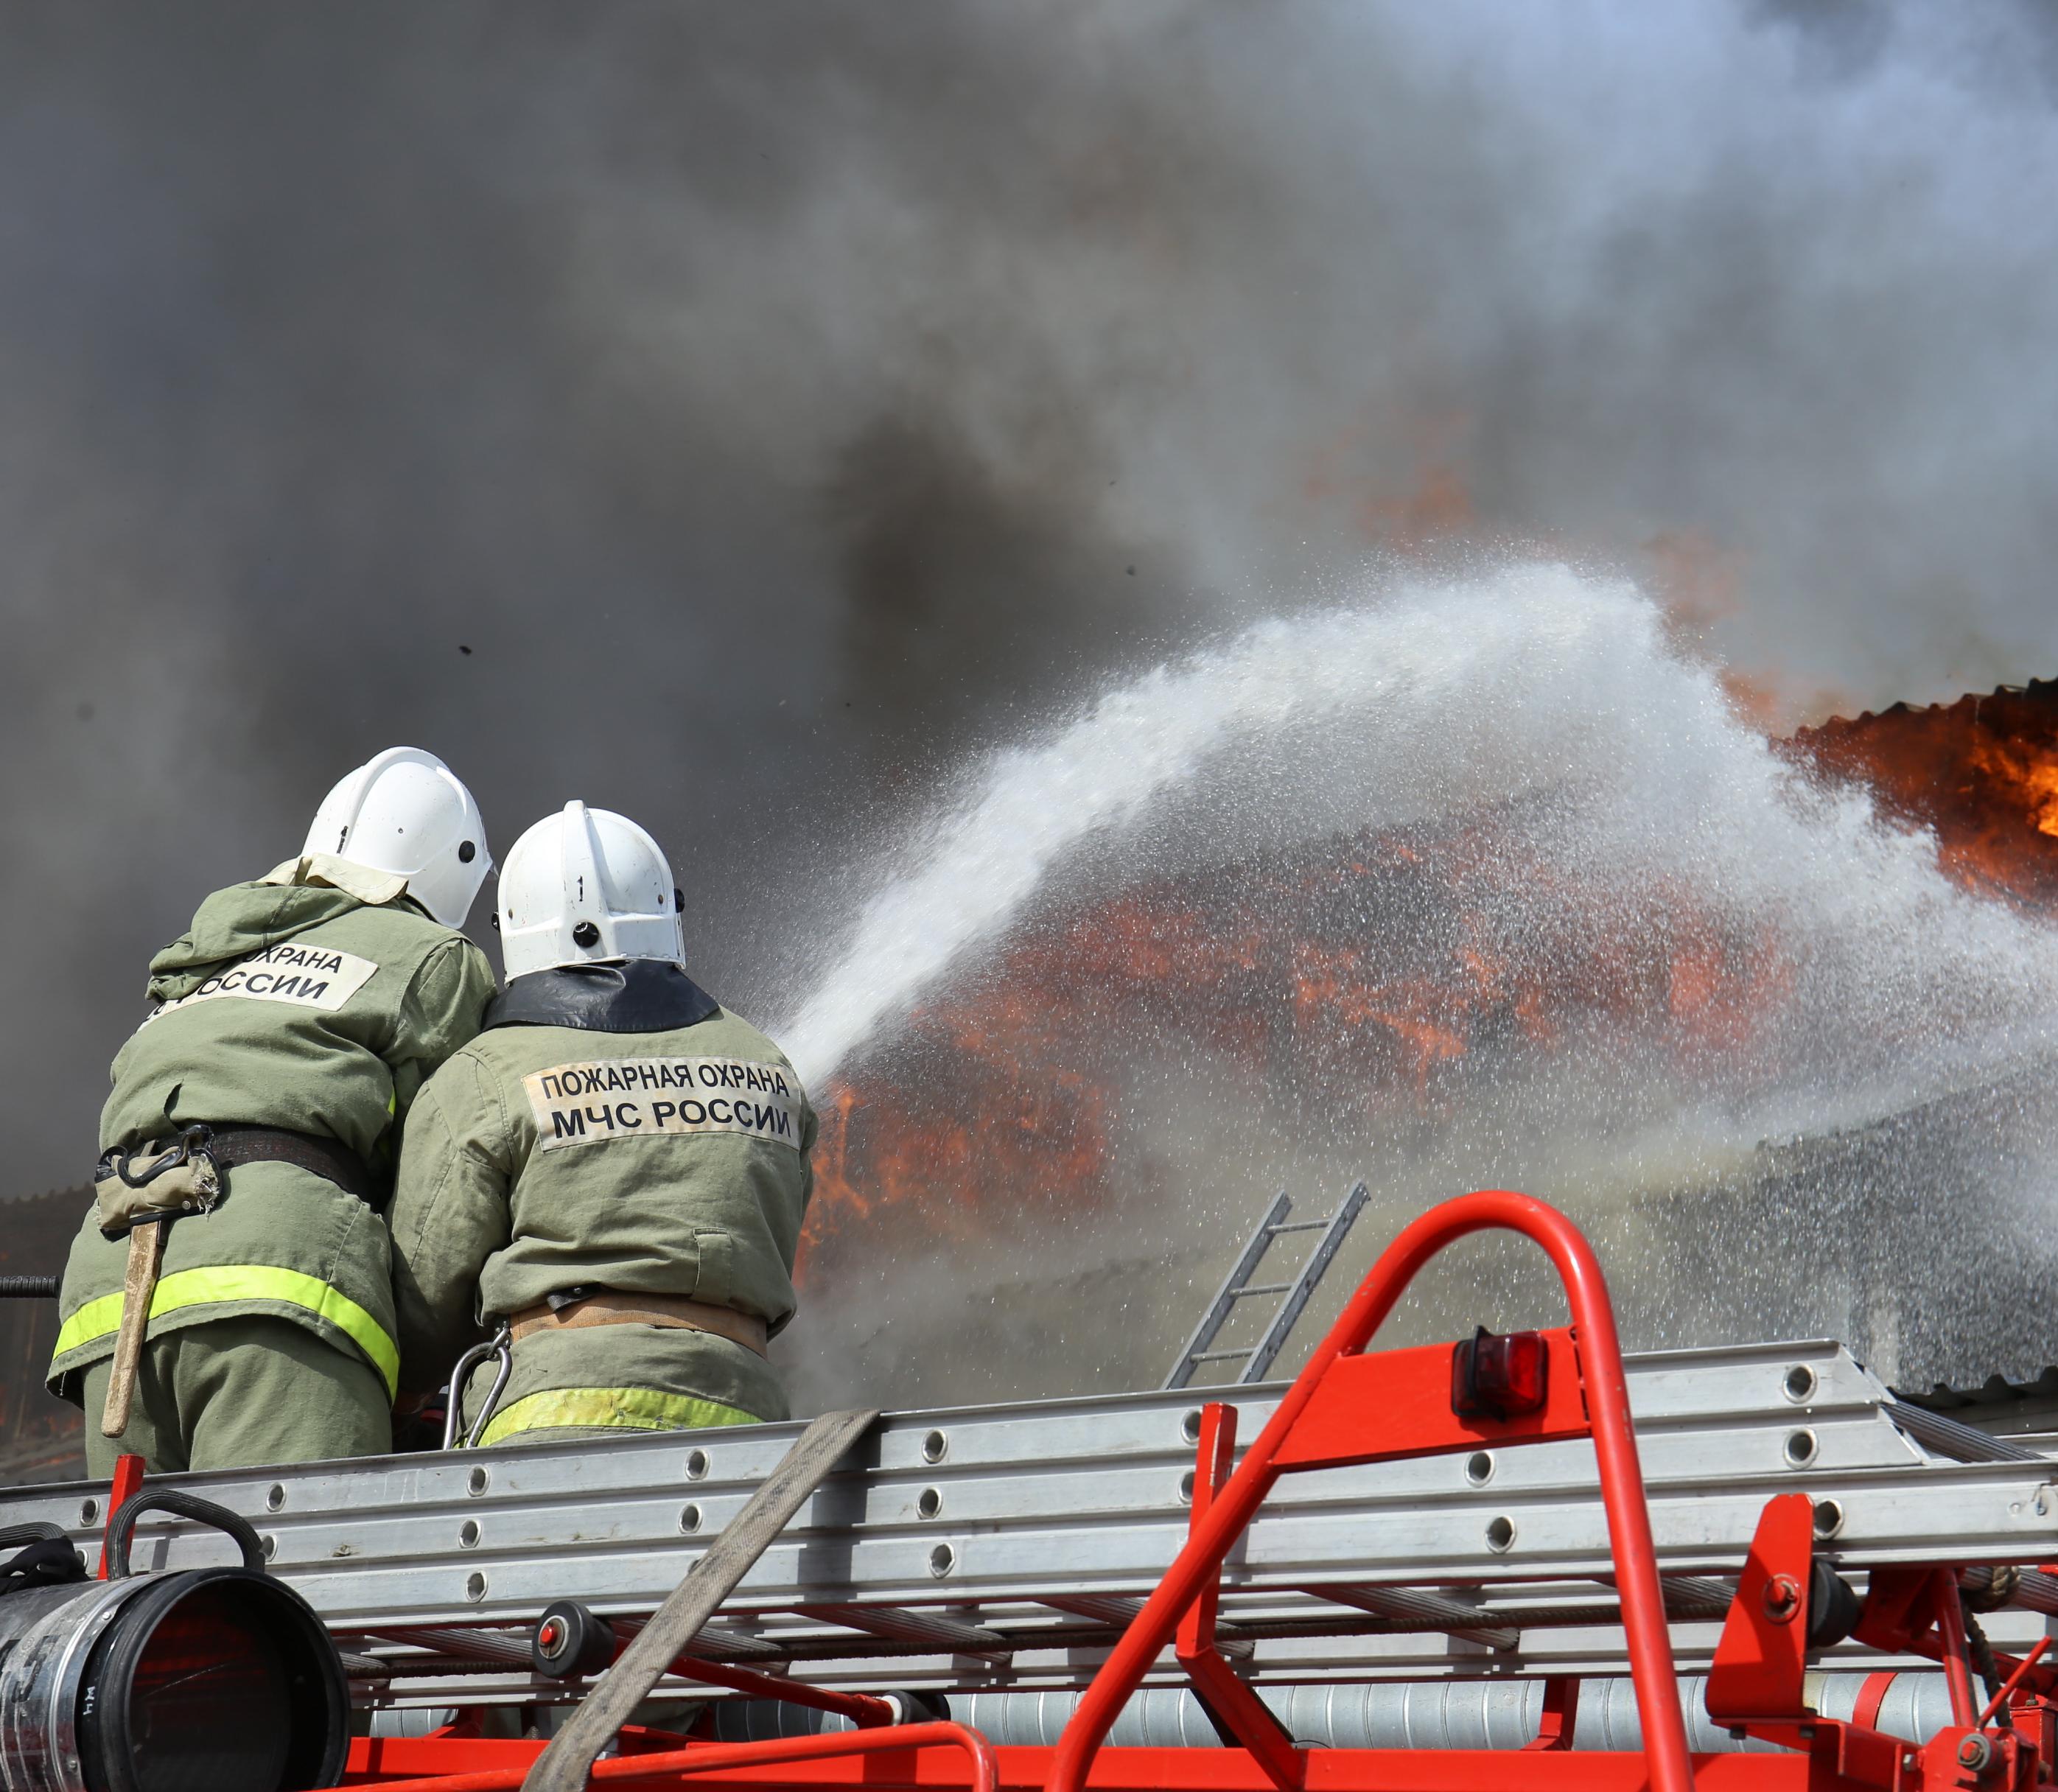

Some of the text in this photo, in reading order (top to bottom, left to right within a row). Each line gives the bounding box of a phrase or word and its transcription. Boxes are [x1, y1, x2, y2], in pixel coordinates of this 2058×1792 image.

[177, 971, 330, 1004] ОССИИ
[541, 1064, 790, 1099] ПОЖАРНАЯ ОХРАНА
[551, 1098, 791, 1138] МЧС РОССИИ
